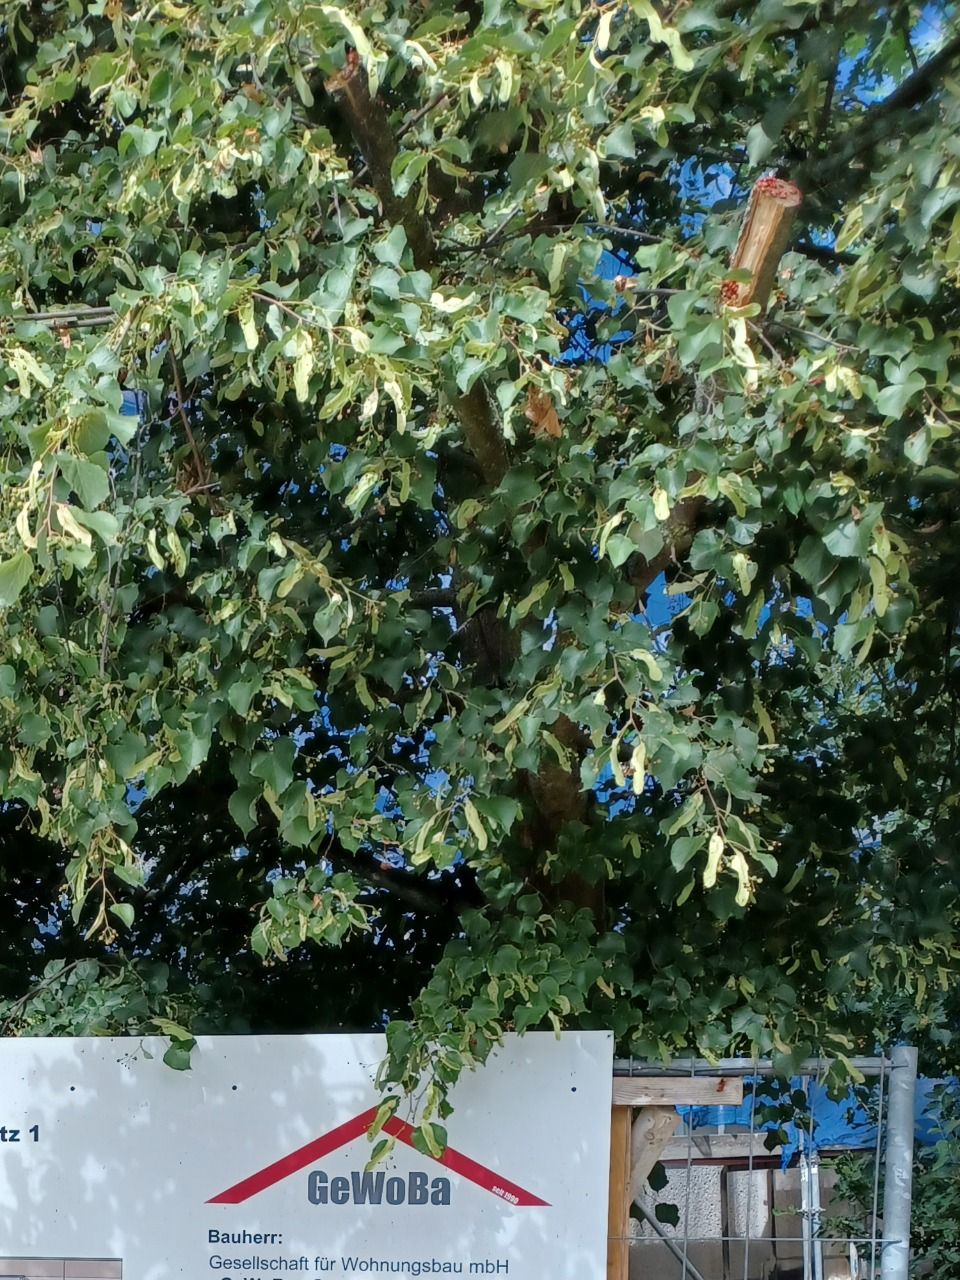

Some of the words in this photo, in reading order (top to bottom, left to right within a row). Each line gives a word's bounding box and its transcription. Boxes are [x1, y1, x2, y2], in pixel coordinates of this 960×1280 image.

[28, 1125, 40, 1144] 1
[307, 1170, 451, 1206] GeWoBa
[207, 1230, 283, 1245] Bauherr:
[209, 1255, 310, 1272] Gesellschaft
[314, 1256, 338, 1272] für
[340, 1257, 463, 1276] Wohnungsbau
[469, 1259, 509, 1275] mbH
